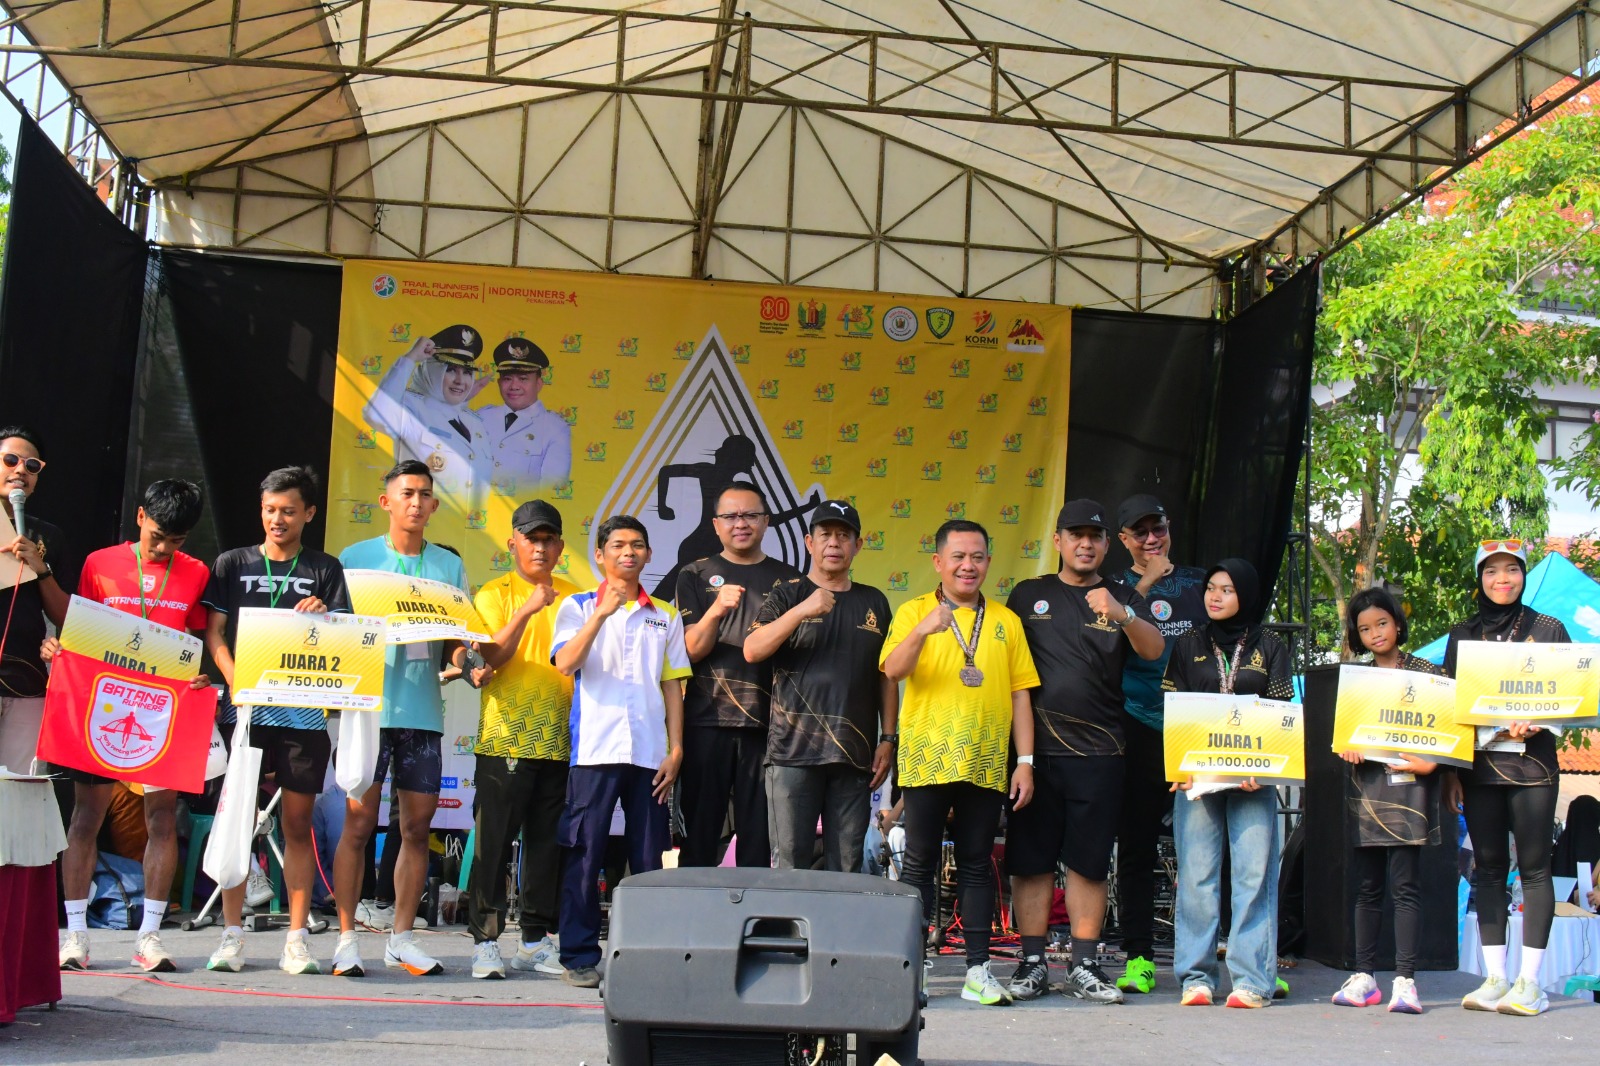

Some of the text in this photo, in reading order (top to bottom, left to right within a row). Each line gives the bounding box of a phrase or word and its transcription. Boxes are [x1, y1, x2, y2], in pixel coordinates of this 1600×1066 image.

[402, 281, 479, 291] TRAIL RUNNERS
[488, 286, 565, 300] INDORUNNERS
[402, 289, 479, 300] PEKALONGAN
[761, 296, 790, 321] 80
[965, 335, 998, 344] KORMI
[240, 575, 315, 596] TSTC
[104, 596, 188, 611] BATANG RUNNERS
[453, 594, 463, 604] 5K
[395, 600, 448, 616] JUARA 3
[407, 616, 456, 627] 500.000
[645, 618, 668, 628] UTAMA
[1156, 620, 1192, 630] RUNNERS
[361, 632, 377, 646] 5K
[179, 649, 194, 664] 5K
[279, 653, 341, 672] JUARA 2
[1577, 657, 1592, 669] 5K
[268, 675, 343, 689] Rp 750.000
[1498, 680, 1557, 694] JUARA 3
[102, 682, 169, 706] BATANG
[122, 698, 164, 713] RUNNERS
[1505, 701, 1560, 711] 500.000
[1281, 715, 1295, 728] 5K
[1378, 708, 1436, 728] JUARA 2
[209, 741, 220, 749] AN
[1207, 733, 1262, 750] JUARA 1
[1367, 732, 1437, 746] Rp 750.000
[1208, 756, 1271, 768] 1.000.000
